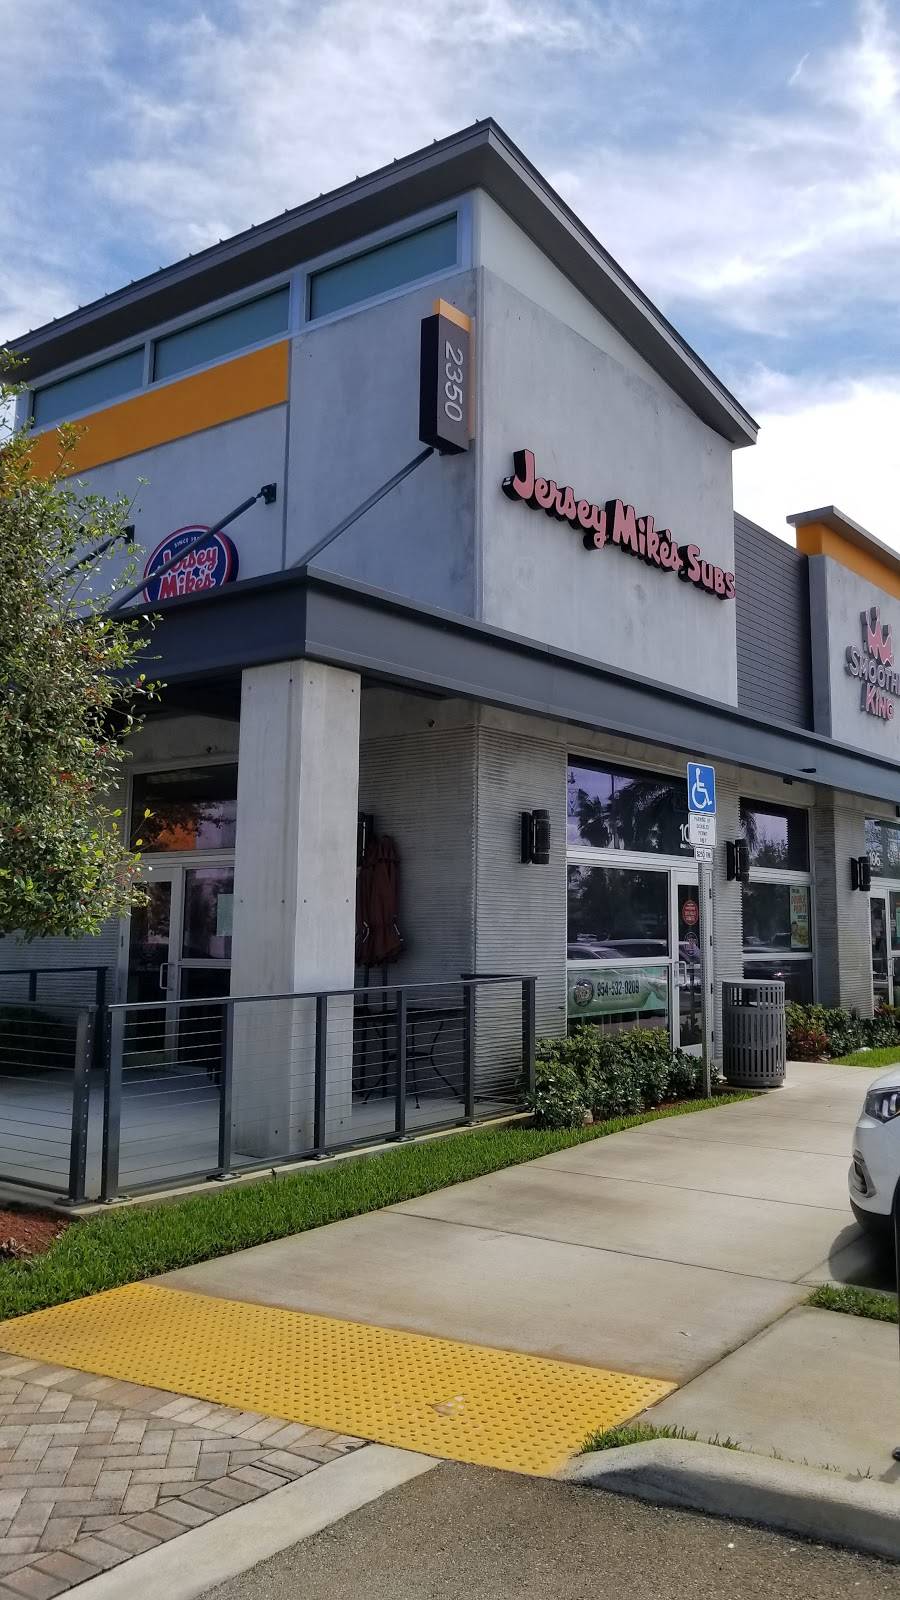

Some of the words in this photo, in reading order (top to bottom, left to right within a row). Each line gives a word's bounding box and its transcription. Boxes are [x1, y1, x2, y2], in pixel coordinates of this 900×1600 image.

[444, 340, 464, 422] 2350
[503, 449, 608, 551] Jersey
[608, 499, 684, 573] Mike's
[863, 682, 895, 721] KING
